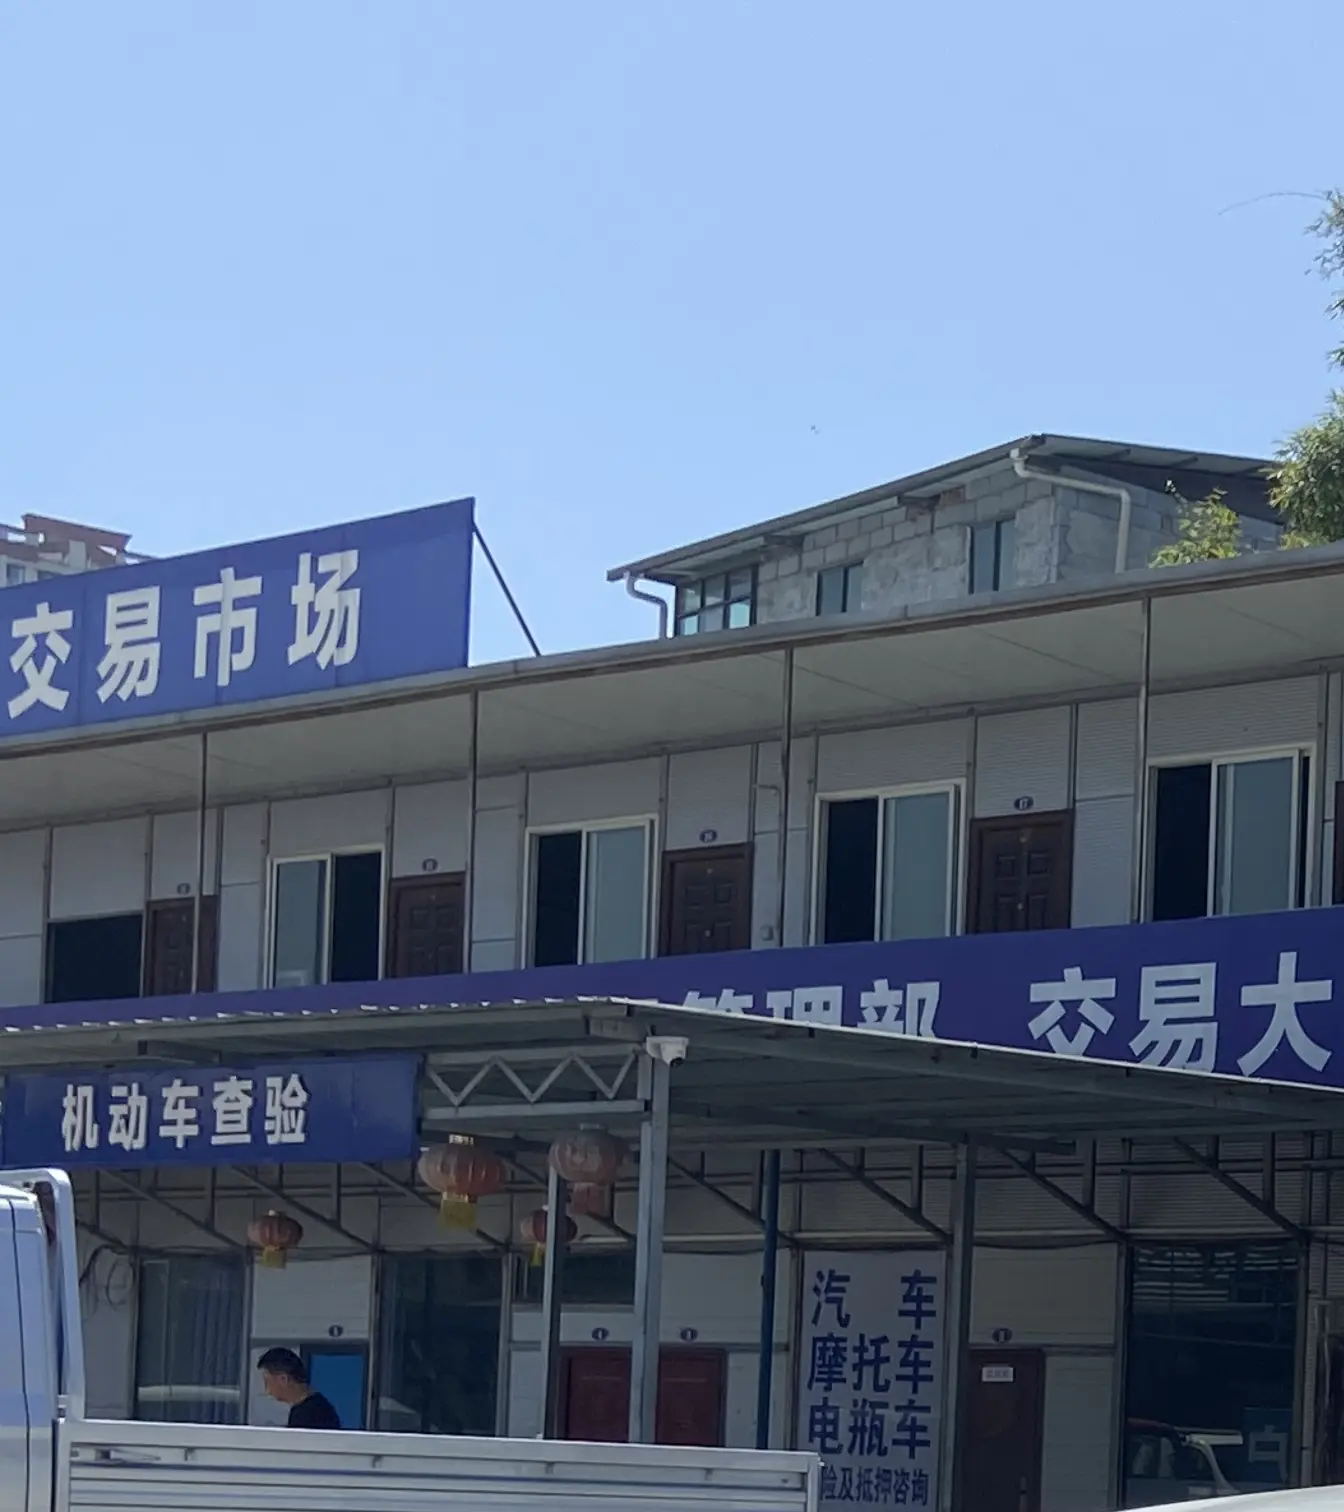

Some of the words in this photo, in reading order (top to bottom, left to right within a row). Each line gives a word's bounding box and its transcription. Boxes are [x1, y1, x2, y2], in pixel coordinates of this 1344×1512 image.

[7, 548, 362, 718] 交易市场
[61, 1073, 309, 1152] 机动车查验
[807, 1332, 935, 1395] 摩托车
[806, 1396, 932, 1460] 电瓶车
